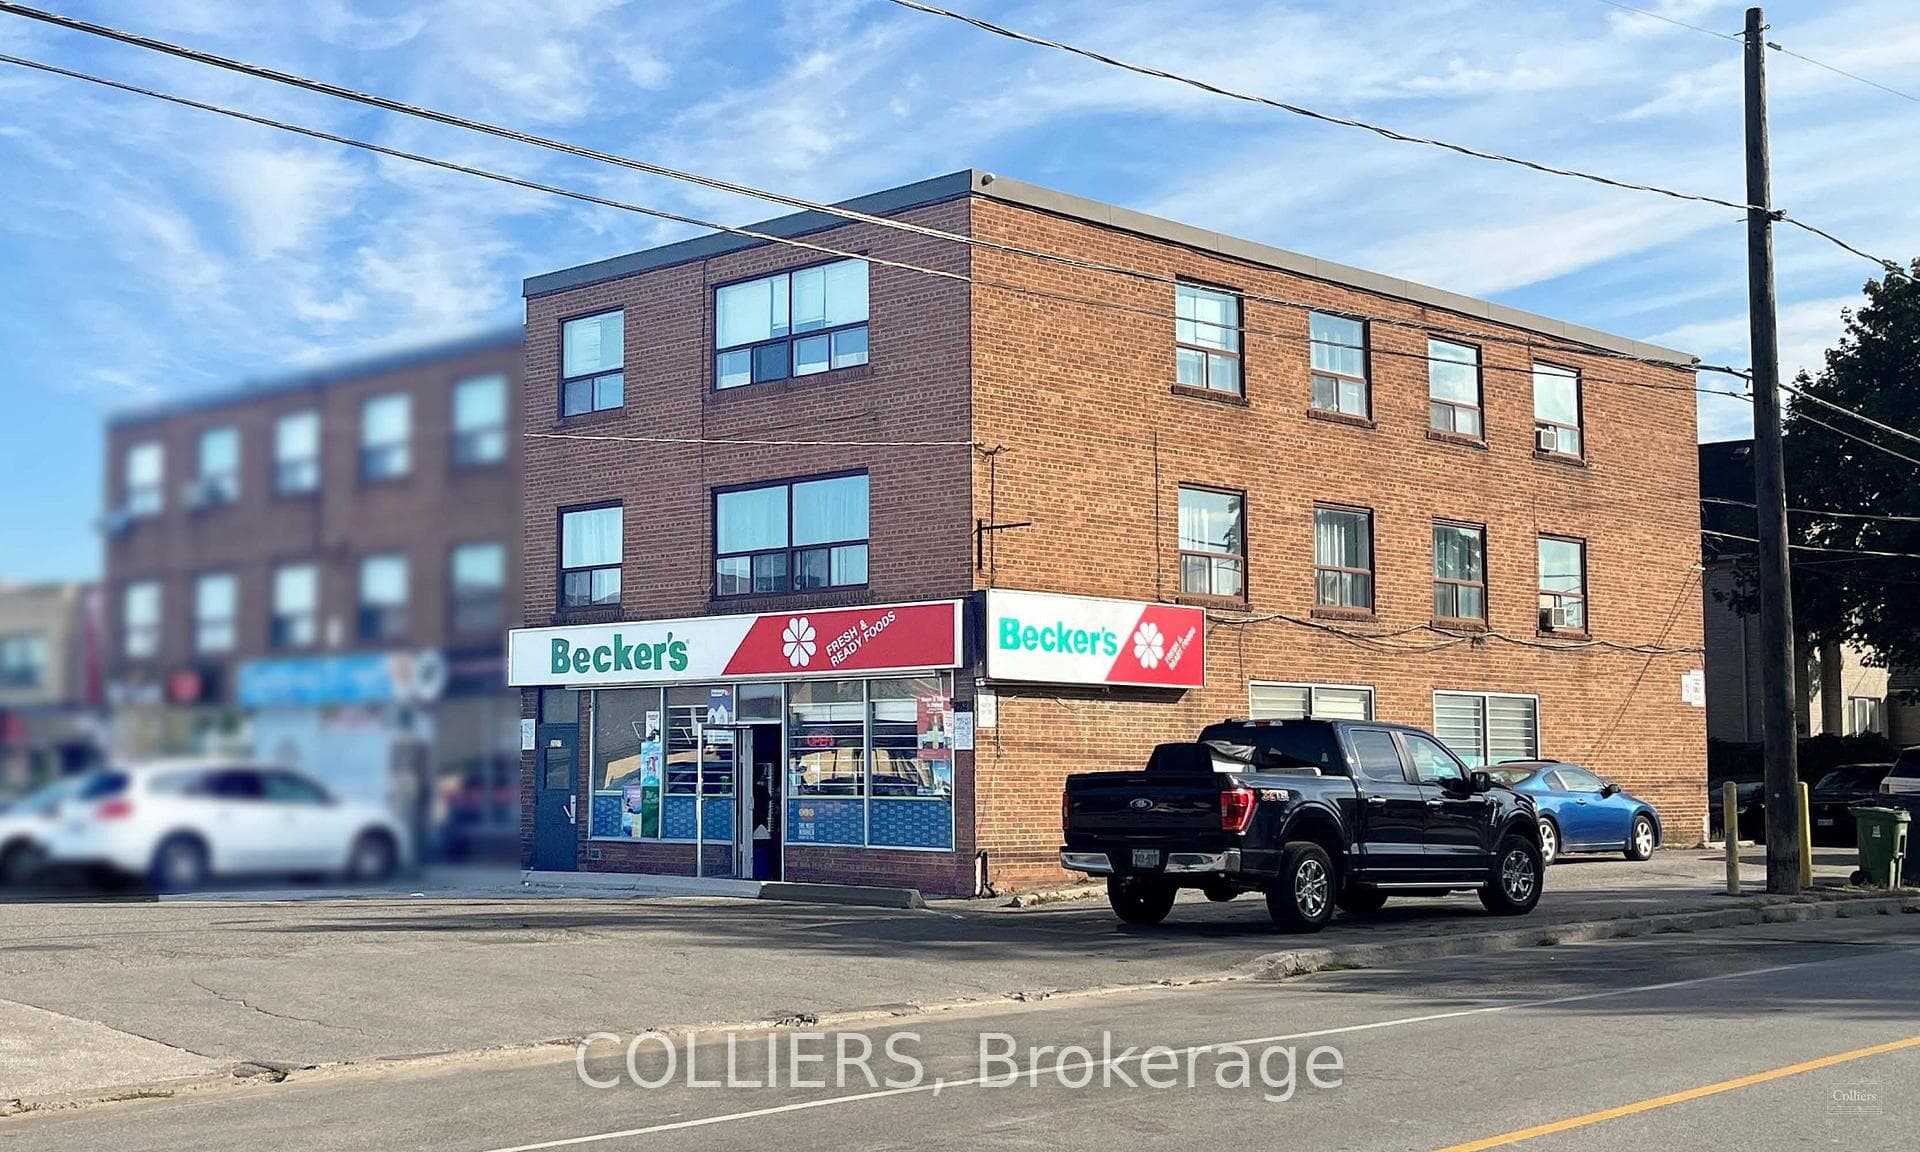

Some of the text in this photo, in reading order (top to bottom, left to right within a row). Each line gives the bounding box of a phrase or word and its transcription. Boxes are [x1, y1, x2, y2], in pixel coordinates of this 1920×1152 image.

[551, 632, 689, 674] Becker's
[825, 619, 869, 657] FRESH &
[830, 610, 897, 668] READY FOODS
[998, 617, 1118, 656] Becker's
